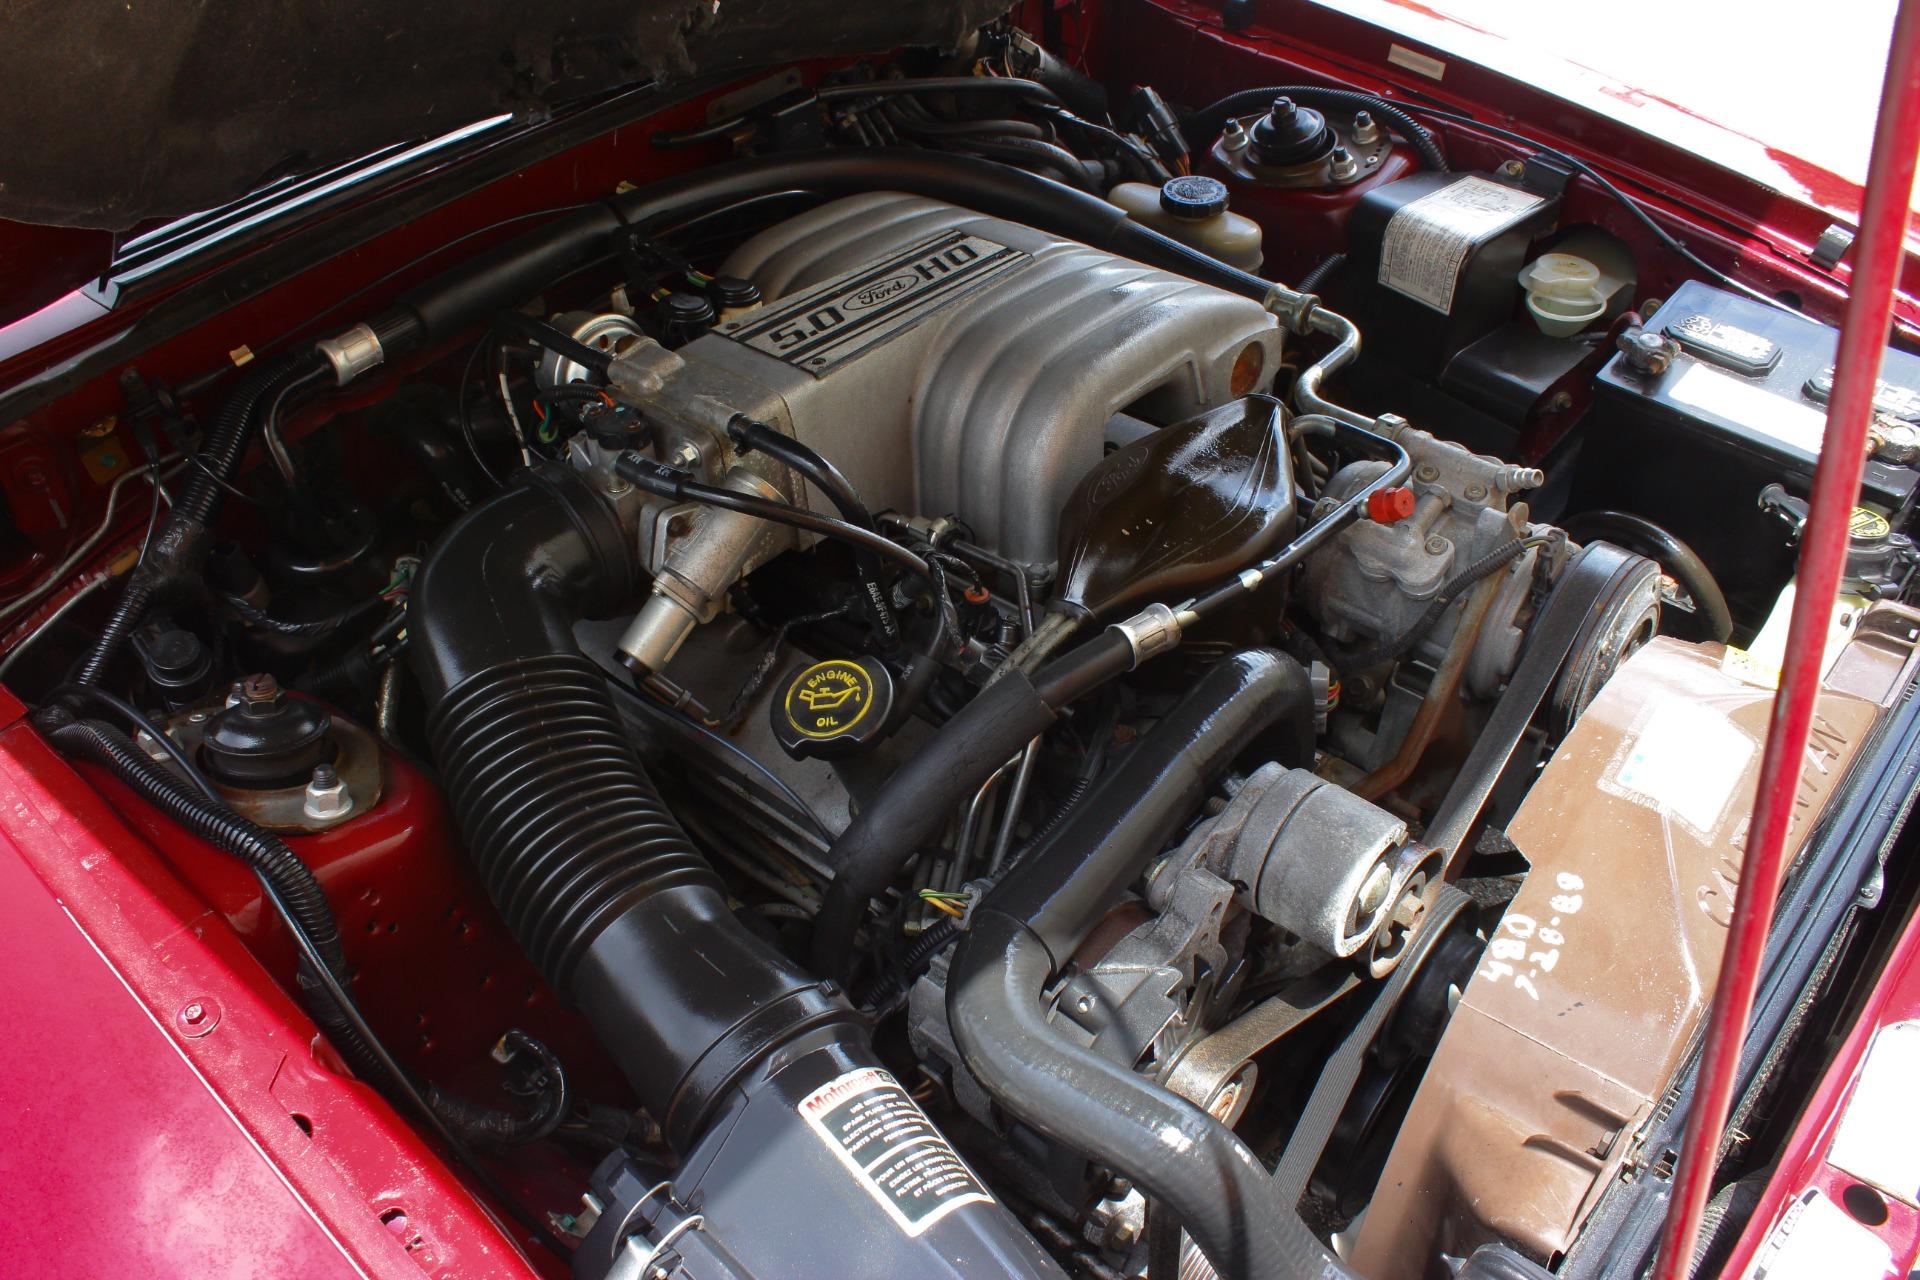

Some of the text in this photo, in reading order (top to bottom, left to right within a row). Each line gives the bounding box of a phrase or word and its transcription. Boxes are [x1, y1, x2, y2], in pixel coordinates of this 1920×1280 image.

[769, 243, 979, 350] 5.0 Ford HO
[807, 670, 858, 689] ENGINE
[816, 716, 839, 728] OIL
